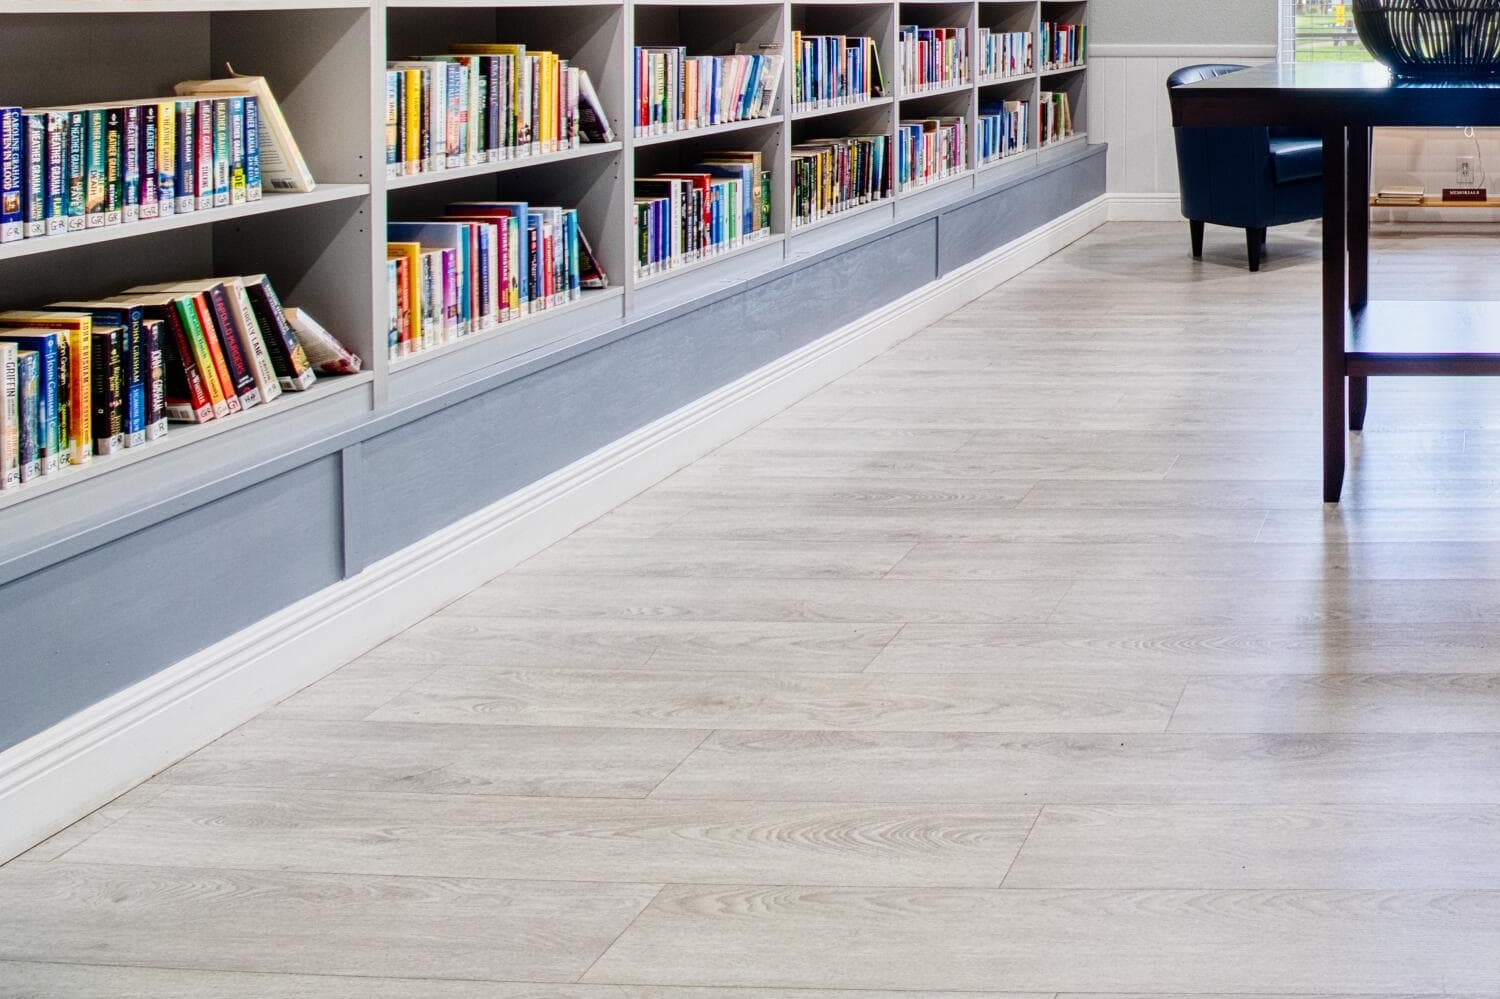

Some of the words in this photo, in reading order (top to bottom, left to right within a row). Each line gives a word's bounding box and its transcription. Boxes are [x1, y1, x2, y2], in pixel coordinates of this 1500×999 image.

[93, 112, 102, 138] HEATHER
[184, 107, 193, 135] HEATHER
[201, 104, 211, 134] HEATHER
[246, 101, 255, 129] HEATHER
[3, 112, 12, 149] WRITTEN
[11, 111, 20, 152] CAROLINE
[108, 130, 118, 158] HEATHER
[146, 123, 155, 148] HEATHER
[163, 120, 171, 148] HEATHER
[247, 129, 256, 153] GRAHAM
[3, 151, 12, 160] IN
[31, 129, 41, 162] HEATHER
[51, 131, 62, 165] HEATHER
[93, 139, 102, 166] GRAHAM
[184, 135, 193, 163] GRAHAM
[201, 134, 211, 161] GRAHAM
[11, 153, 20, 189] GRAHAM
[108, 158, 118, 182] GRAHAM
[146, 150, 155, 175] GRAHAM
[162, 148, 170, 173] GRAHAM
[3, 162, 12, 190] BLOOD
[31, 163, 41, 194] GRAHAM
[51, 165, 61, 196] GRAHAM
[51, 220, 65, 231] GR
[133, 321, 141, 344] JOHN
[242, 305, 256, 337] FIREFLY
[251, 337, 264, 358] LANE
[133, 345, 141, 383] GRISHAM
[6, 361, 16, 398] GRIFFIN
[26, 463, 40, 478] GR
